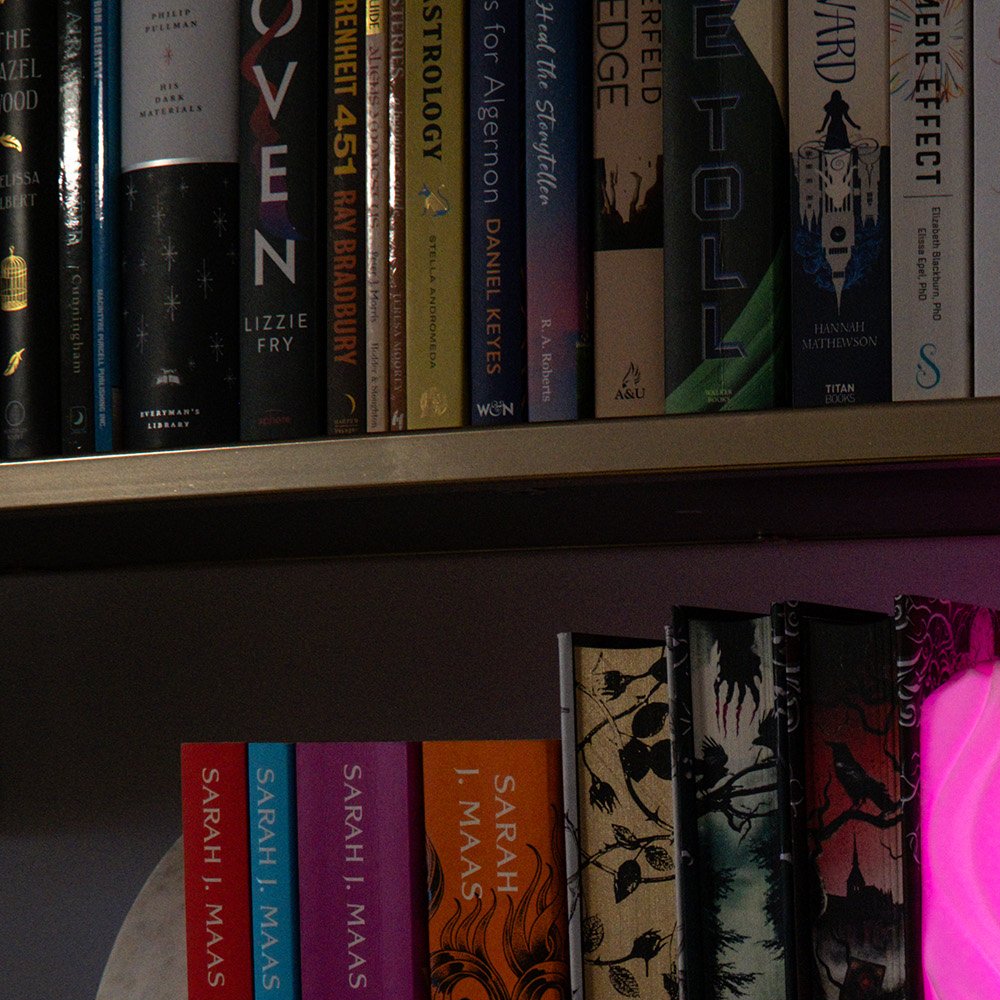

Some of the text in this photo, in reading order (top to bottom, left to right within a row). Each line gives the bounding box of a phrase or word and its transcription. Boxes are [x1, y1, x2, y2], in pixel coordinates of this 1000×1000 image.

[145, 21, 198, 33] PULLMAN
[152, 9, 191, 20] PHILIP
[160, 82, 179, 91] HIS
[422, 0, 443, 161] STROLOGY
[537, 61, 557, 89] the
[0, 90, 39, 113] OOD
[155, 94, 185, 103] DARK
[140, 105, 203, 118] MATERIALS
[478, 23, 506, 203] for Algernon
[333, 104, 358, 176] 451
[915, 79, 941, 184] EFFECT
[532, 100, 557, 206] Storyteller
[932, 207, 941, 249] Elizabeth
[917, 228, 927, 255] Elissa
[333, 190, 359, 366] RAY BRADBURY
[429, 235, 437, 369] STELLA ANDROMEDA
[485, 218, 501, 375] DANIEL KEYES
[918, 283, 927, 300] PhD
[72, 274, 84, 374] Cunningham
[244, 313, 308, 332] LIZZIE
[933, 303, 942, 321] PhD
[814, 321, 865, 335] HANNAH
[257, 336, 294, 353] FRY
[801, 336, 878, 351] MATHEWSON
[541, 353, 553, 403] Roberts
[825, 383, 855, 393] TITAN
[615, 387, 645, 400] A&U
[825, 393, 855, 404] BOOKS
[140, 408, 200, 418] EVERYMAN'S
[476, 401, 515, 417] W&N
[147, 421, 190, 430] LIBRARY
[454, 768, 483, 901] J. MAAS
[494, 774, 518, 893] SARAH
[201, 767, 225, 988] SARAH J. MAAS
[256, 767, 281, 990] SARAH J. MAAS
[342, 764, 367, 990] SARAH J. MAAS
